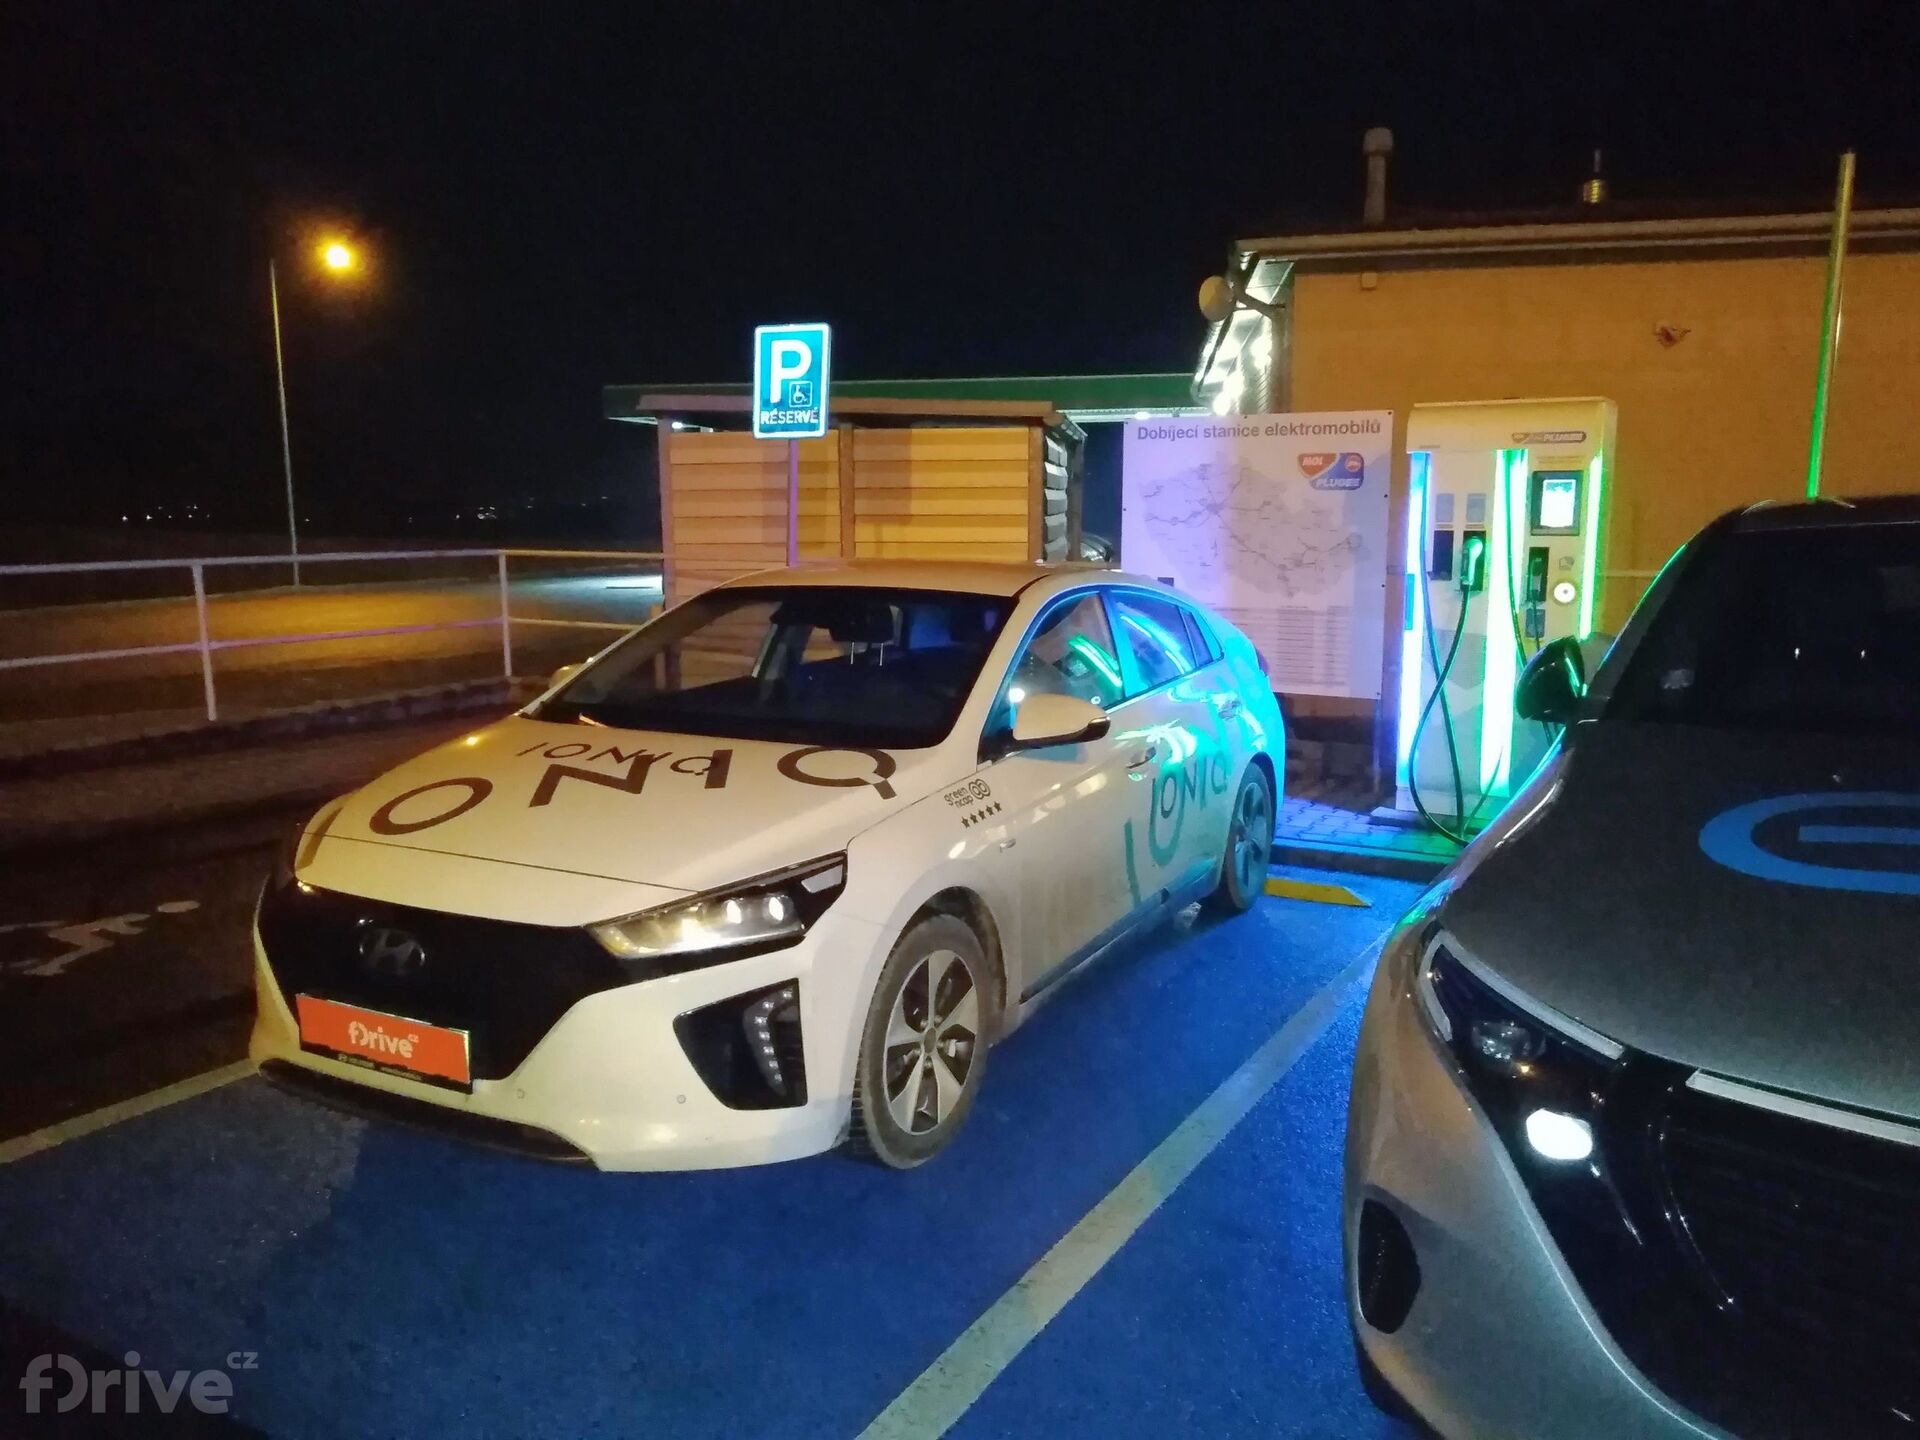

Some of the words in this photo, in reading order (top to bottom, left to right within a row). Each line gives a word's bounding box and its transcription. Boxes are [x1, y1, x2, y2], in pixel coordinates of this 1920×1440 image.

[770, 339, 812, 404] P
[760, 407, 819, 425] RÉSERVÉ
[1203, 423, 1260, 439] stanice
[1264, 419, 1381, 437] elektromobilů
[944, 787, 969, 807] green
